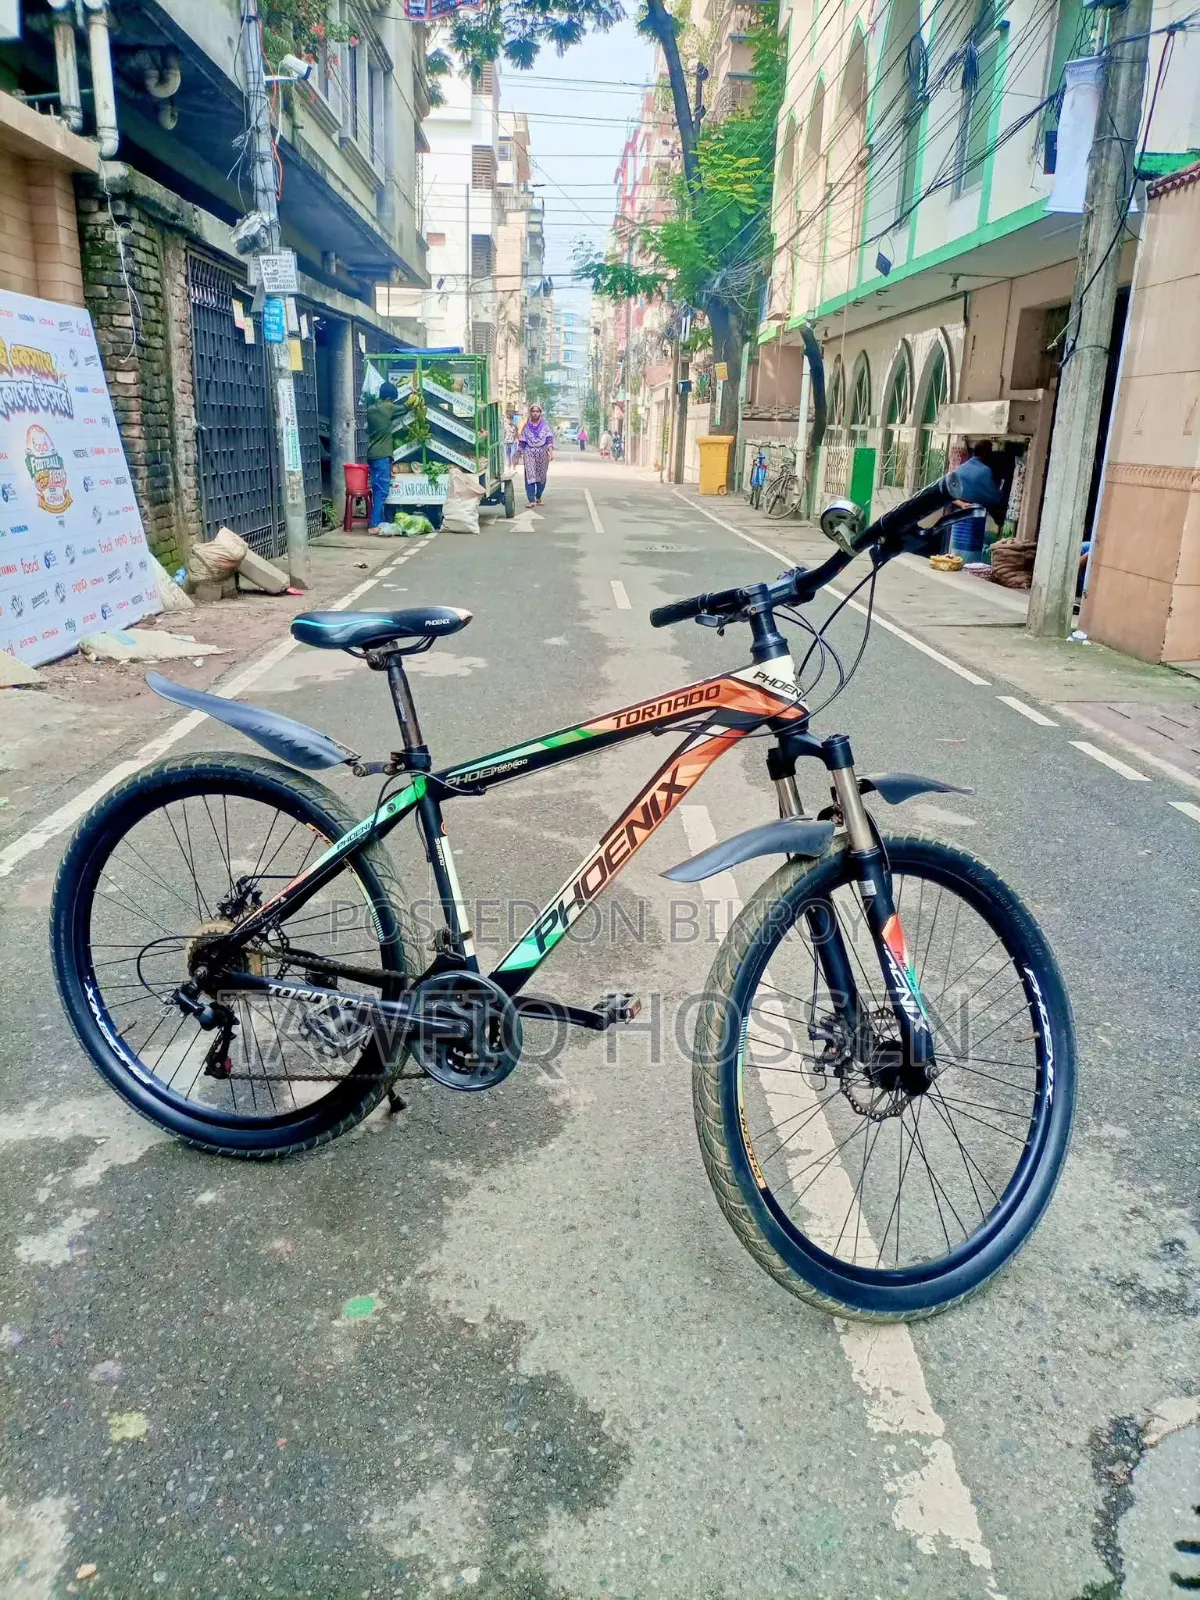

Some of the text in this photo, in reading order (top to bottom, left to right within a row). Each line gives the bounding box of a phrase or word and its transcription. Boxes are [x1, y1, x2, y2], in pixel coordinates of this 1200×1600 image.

[404, 483, 415, 496] ASB
[416, 483, 449, 496] GROCERIES
[424, 618, 451, 627] PHOENIX
[612, 684, 722, 729] TORNADO
[534, 764, 688, 955] PHOENIX
[83, 981, 154, 1085] PHOENIX
[1023, 966, 1055, 1106] PHOENIX
